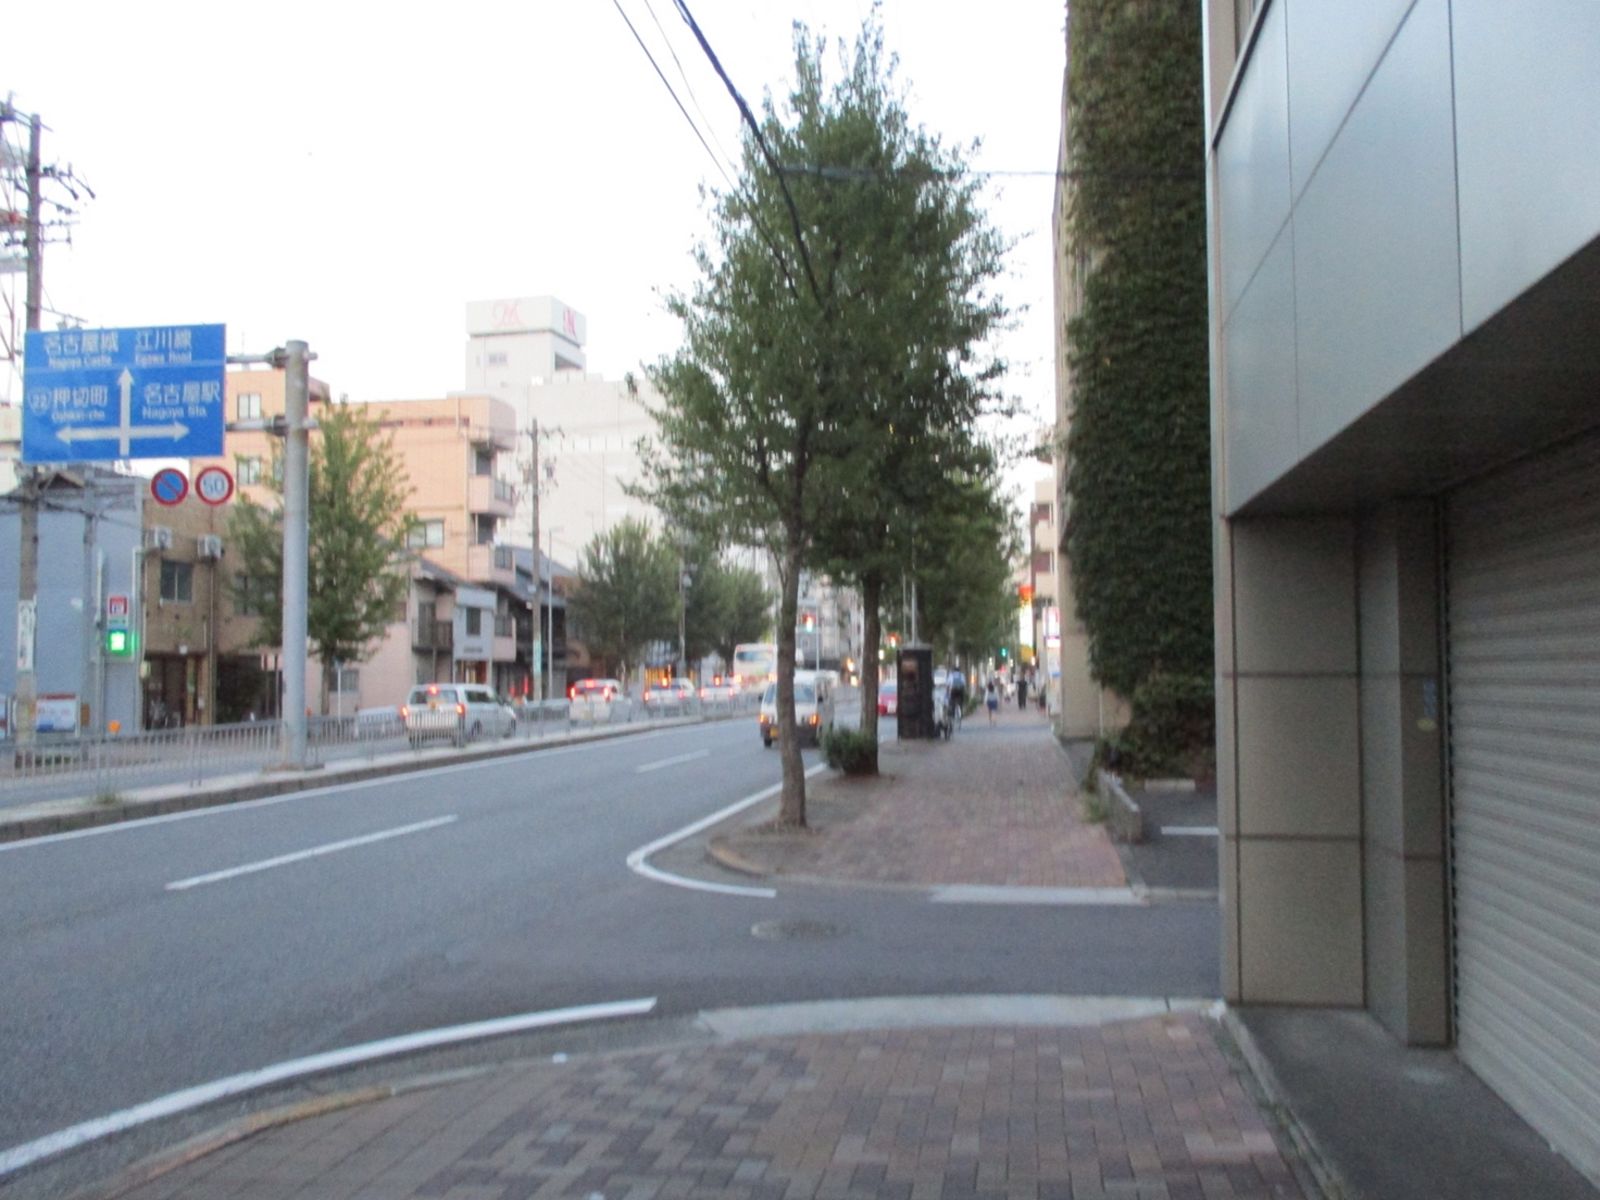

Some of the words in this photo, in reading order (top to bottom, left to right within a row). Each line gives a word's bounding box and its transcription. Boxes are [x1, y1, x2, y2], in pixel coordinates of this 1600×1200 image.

[144, 380, 220, 405] 名古屋駅
[203, 478, 225, 493] 50
